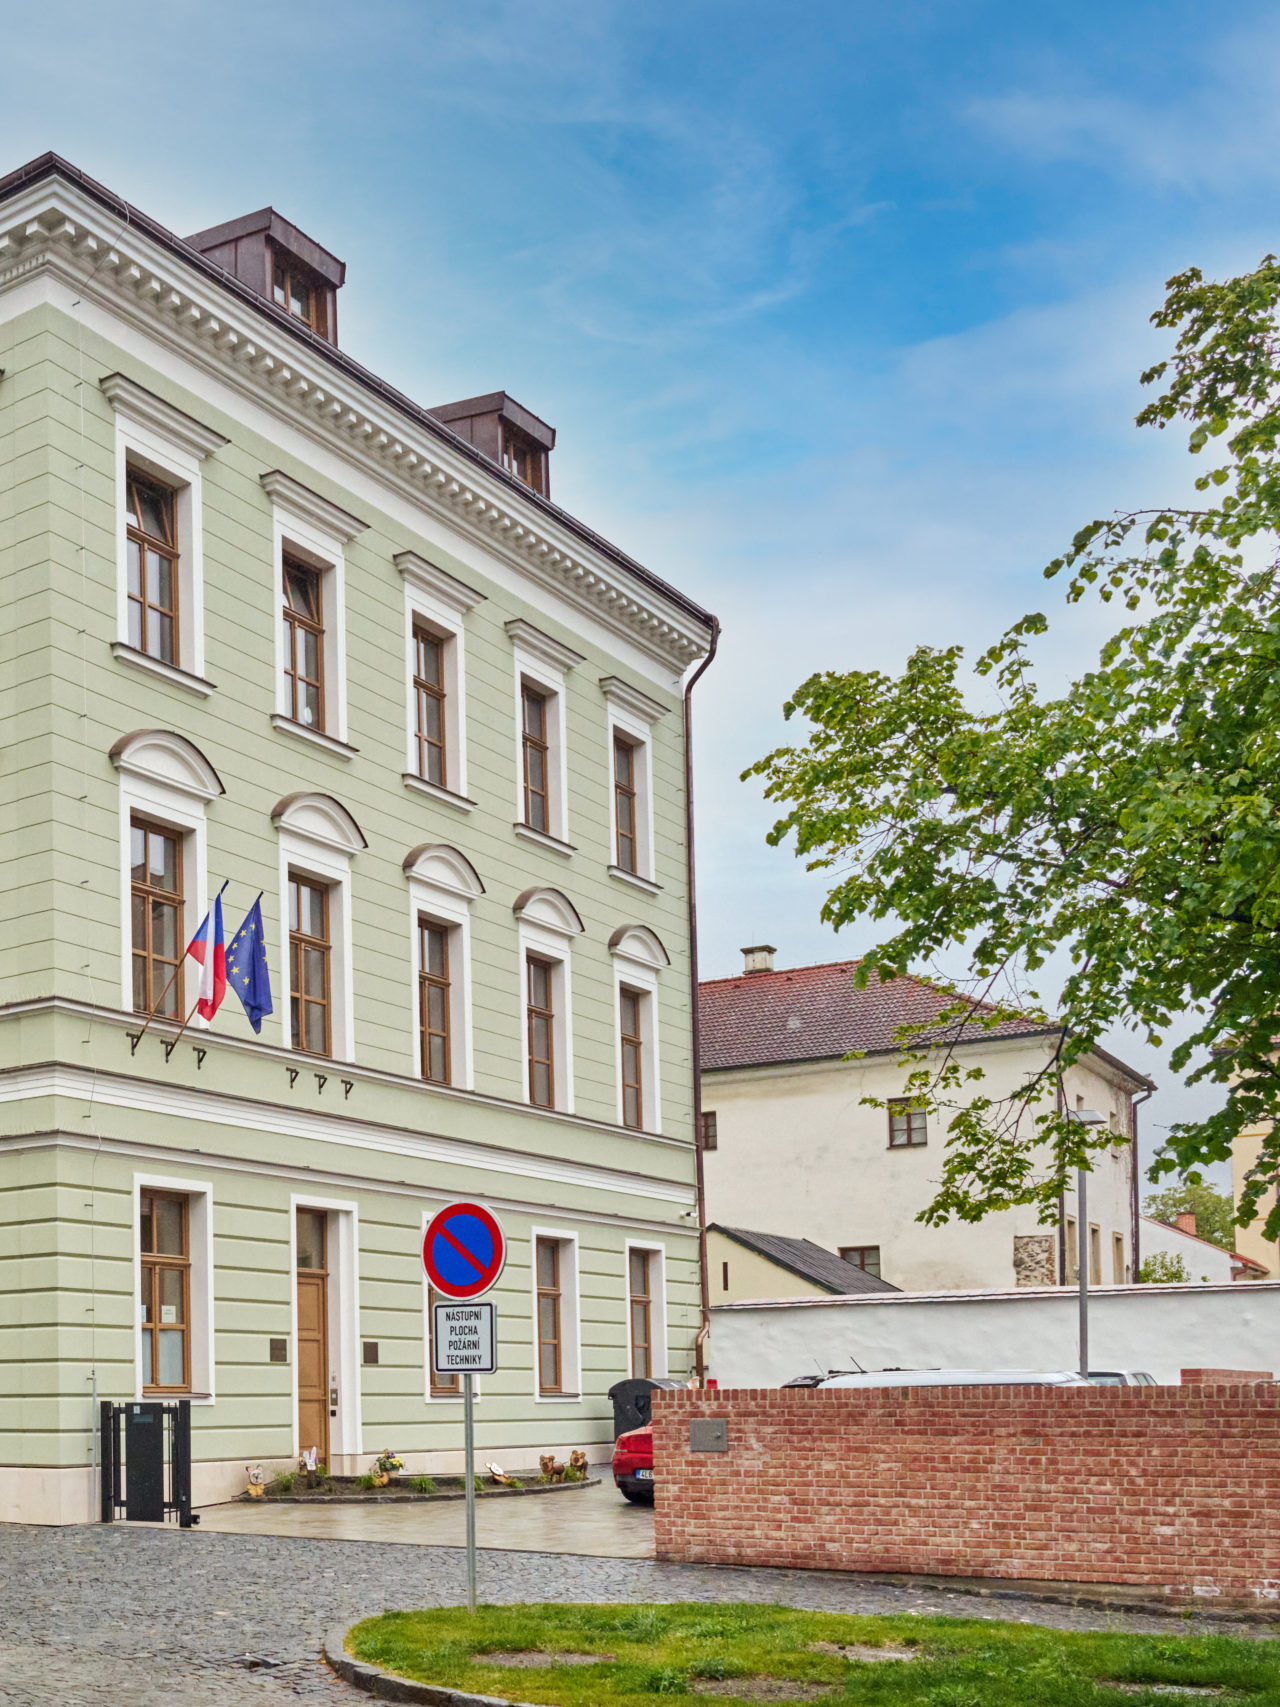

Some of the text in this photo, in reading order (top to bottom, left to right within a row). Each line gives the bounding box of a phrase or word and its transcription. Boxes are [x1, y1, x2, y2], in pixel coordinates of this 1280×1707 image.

[445, 1308, 482, 1321] NÁSTUPNÍ
[449, 1325, 478, 1336] PLOCHA
[448, 1338, 480, 1350] POŽÁRNÍ
[446, 1354, 482, 1365] TECHNIKY
